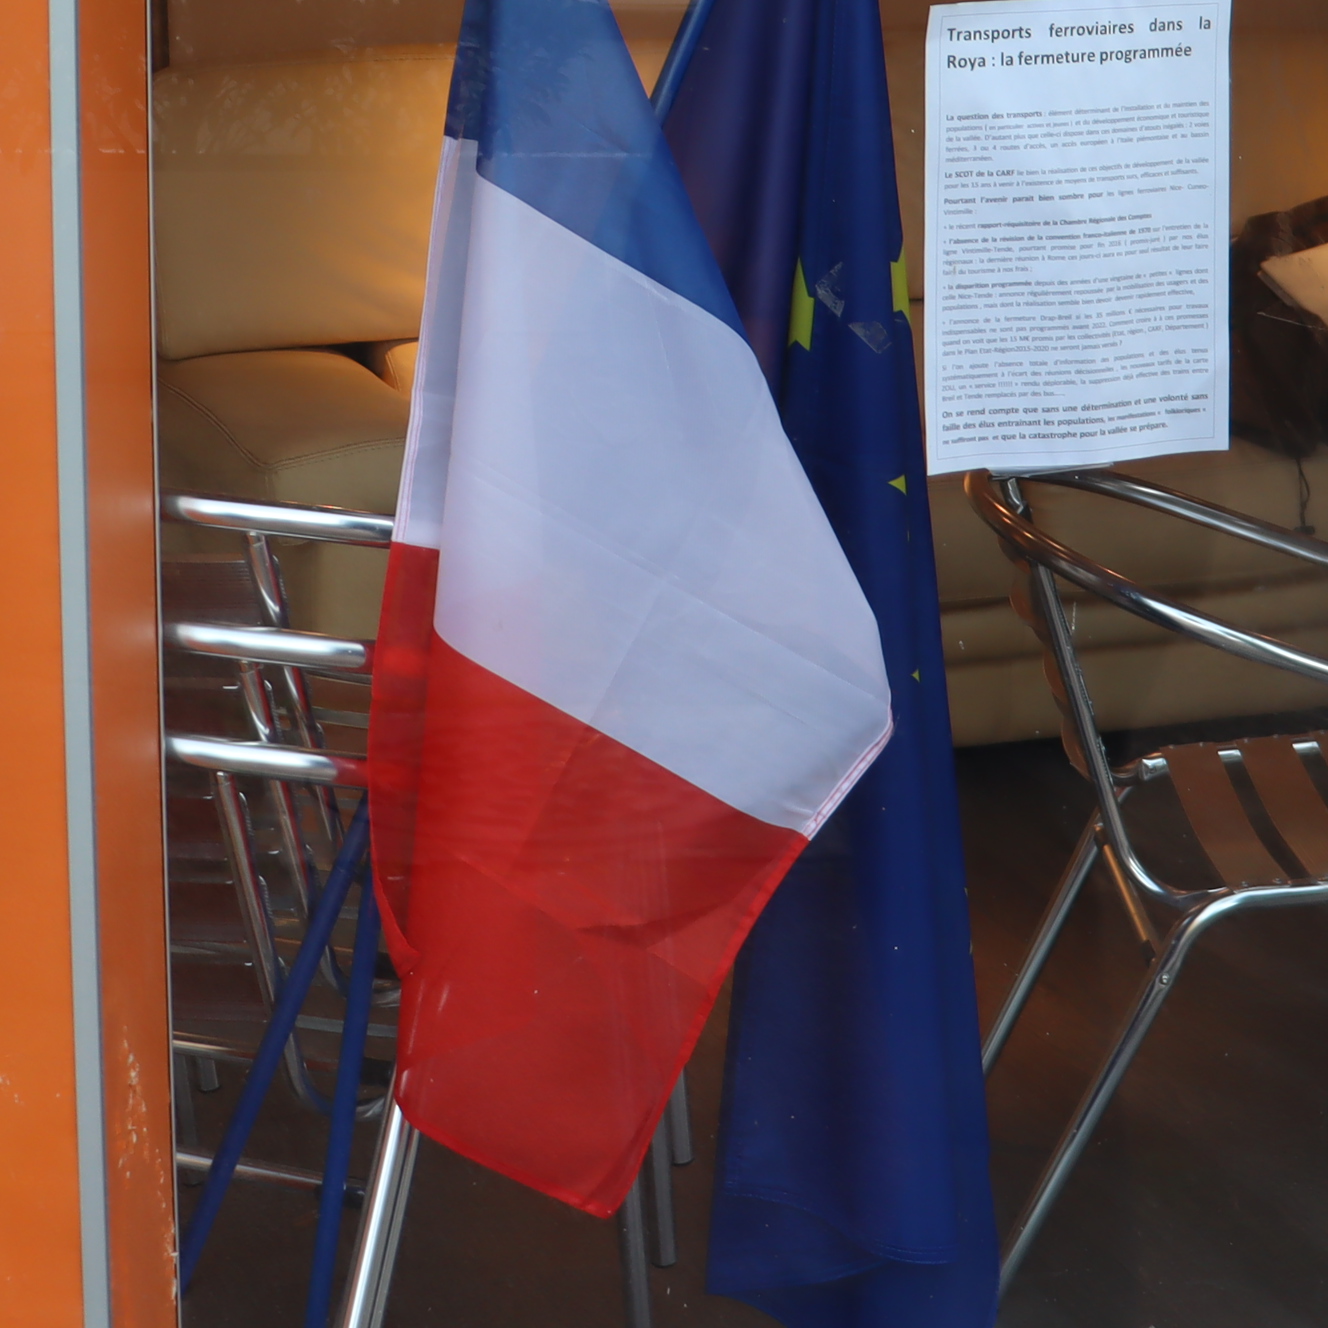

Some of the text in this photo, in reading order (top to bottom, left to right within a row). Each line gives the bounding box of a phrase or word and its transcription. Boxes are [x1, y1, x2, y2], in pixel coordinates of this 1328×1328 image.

[947, 16, 1211, 43] Transports ferroviaires dans la
[947, 55, 985, 70] Roya
[1001, 52, 1013, 66] la
[1018, 51, 1095, 65] fermeture
[1100, 43, 1191, 65] programmée
[957, 112, 989, 121] question
[1007, 110, 1042, 119] transports
[967, 407, 985, 415] rend
[989, 406, 1019, 415] compte
[1081, 399, 1132, 411] détermination
[1159, 392, 1188, 402] volonté
[942, 422, 960, 431] faille
[963, 421, 976, 429] des
[978, 420, 995, 428] élus
[1001, 433, 1017, 441] que
[1028, 430, 1077, 439] catastrophe
[1080, 430, 1098, 439] pour
[1107, 425, 1127, 434] vallée
